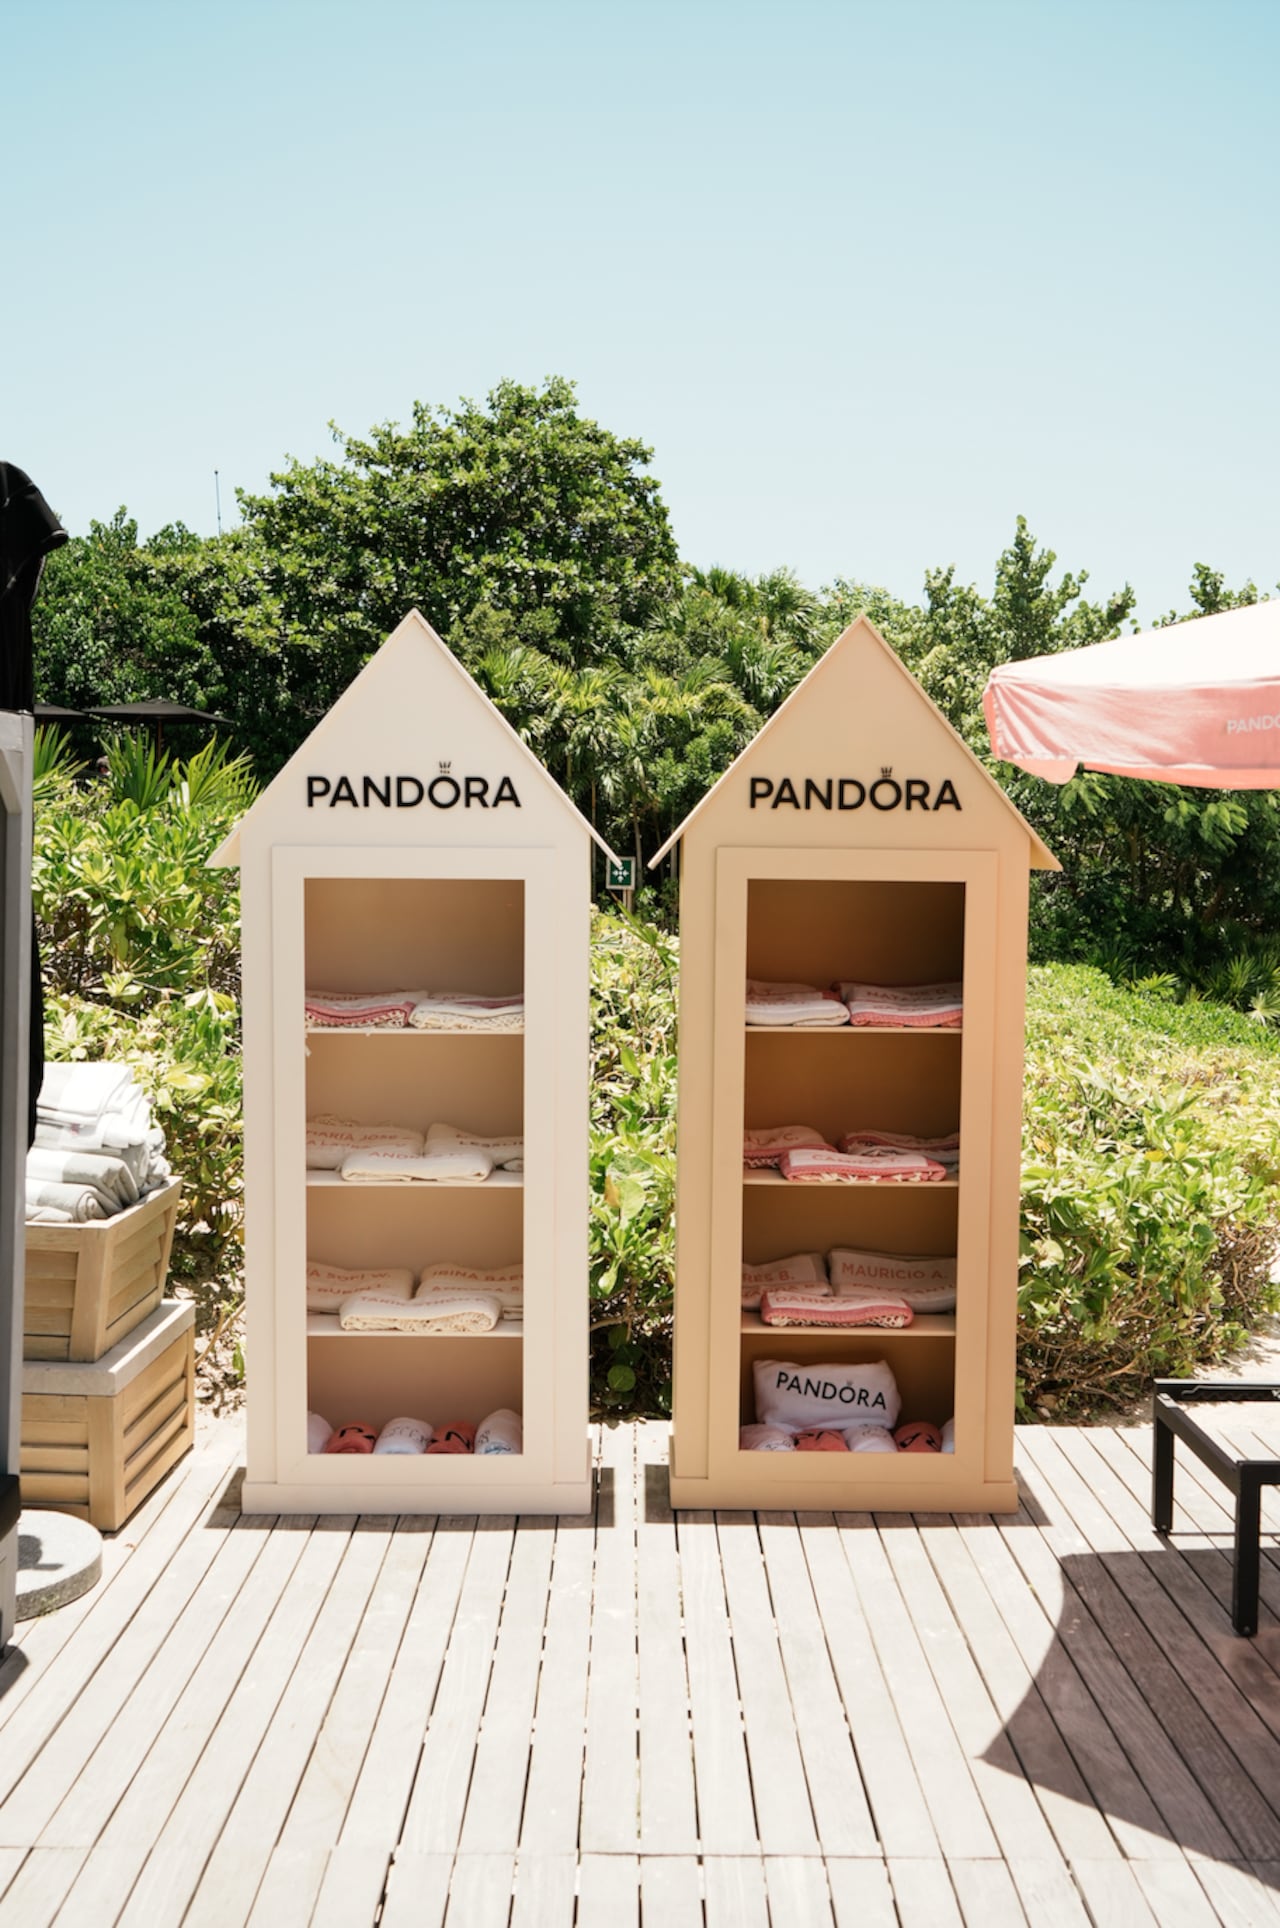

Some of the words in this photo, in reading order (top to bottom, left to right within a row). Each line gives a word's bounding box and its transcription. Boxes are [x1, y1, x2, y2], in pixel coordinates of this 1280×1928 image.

[307, 776, 521, 809] PANDORA
[750, 777, 962, 811] PANDORA
[841, 1262, 925, 1280] MAURICIO
[775, 1371, 887, 1410] PANDORA
